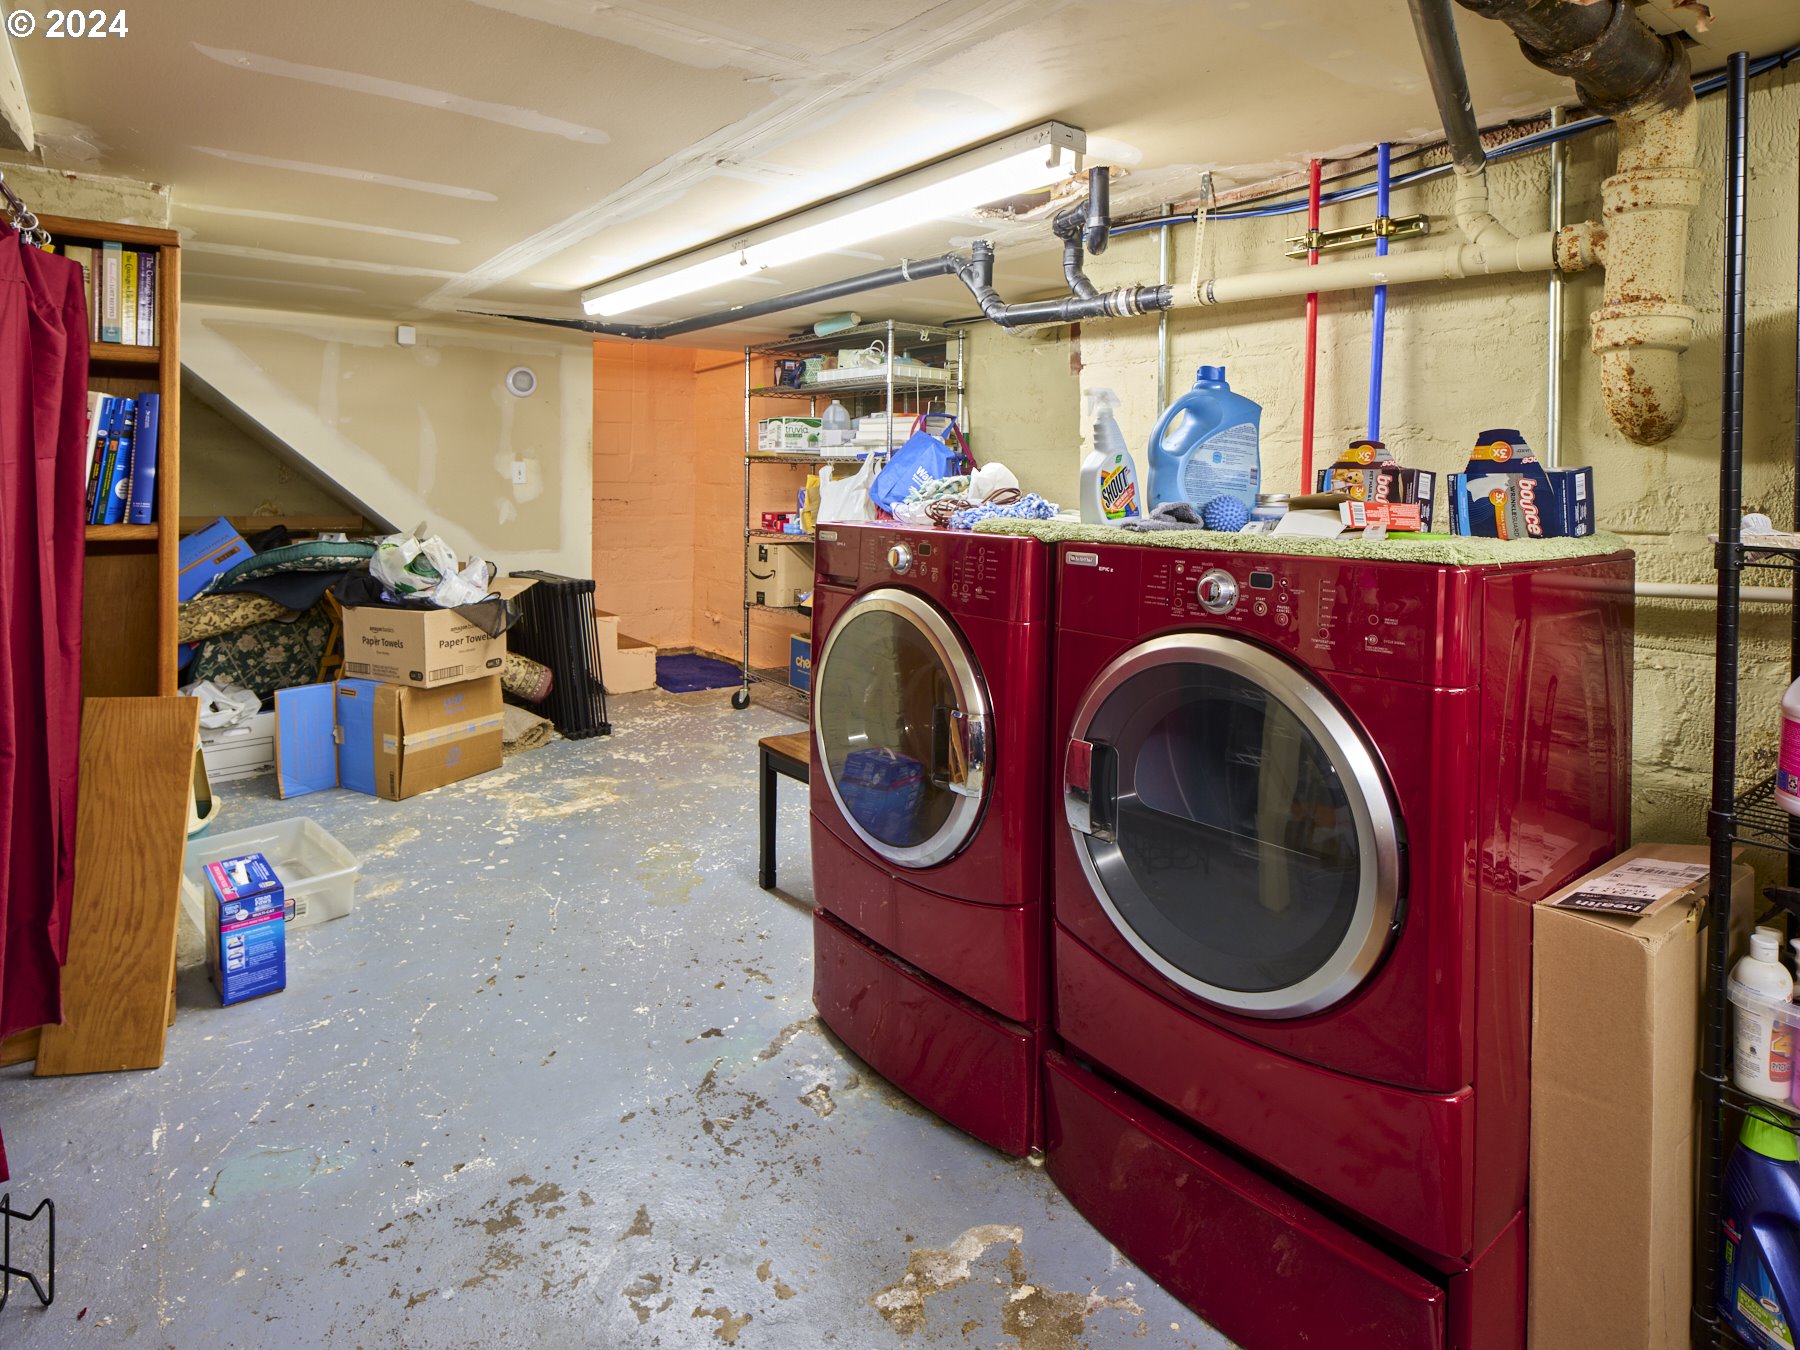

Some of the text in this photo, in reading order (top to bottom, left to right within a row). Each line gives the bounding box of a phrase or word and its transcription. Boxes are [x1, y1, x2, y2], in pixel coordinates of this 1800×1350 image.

[146, 256, 154, 269] The
[146, 269, 154, 296] Courage
[785, 424, 808, 433] truvia
[1357, 450, 1372, 462] 3x
[1492, 448, 1508, 459] 3x
[1102, 465, 1129, 509] SHOUT
[1356, 486, 1365, 499] 3x
[1375, 474, 1392, 504] bou
[1495, 492, 1505, 503] 3x
[1519, 478, 1543, 536] bounce
[361, 636, 404, 649] Paper Towels
[439, 638, 464, 649] Paper
